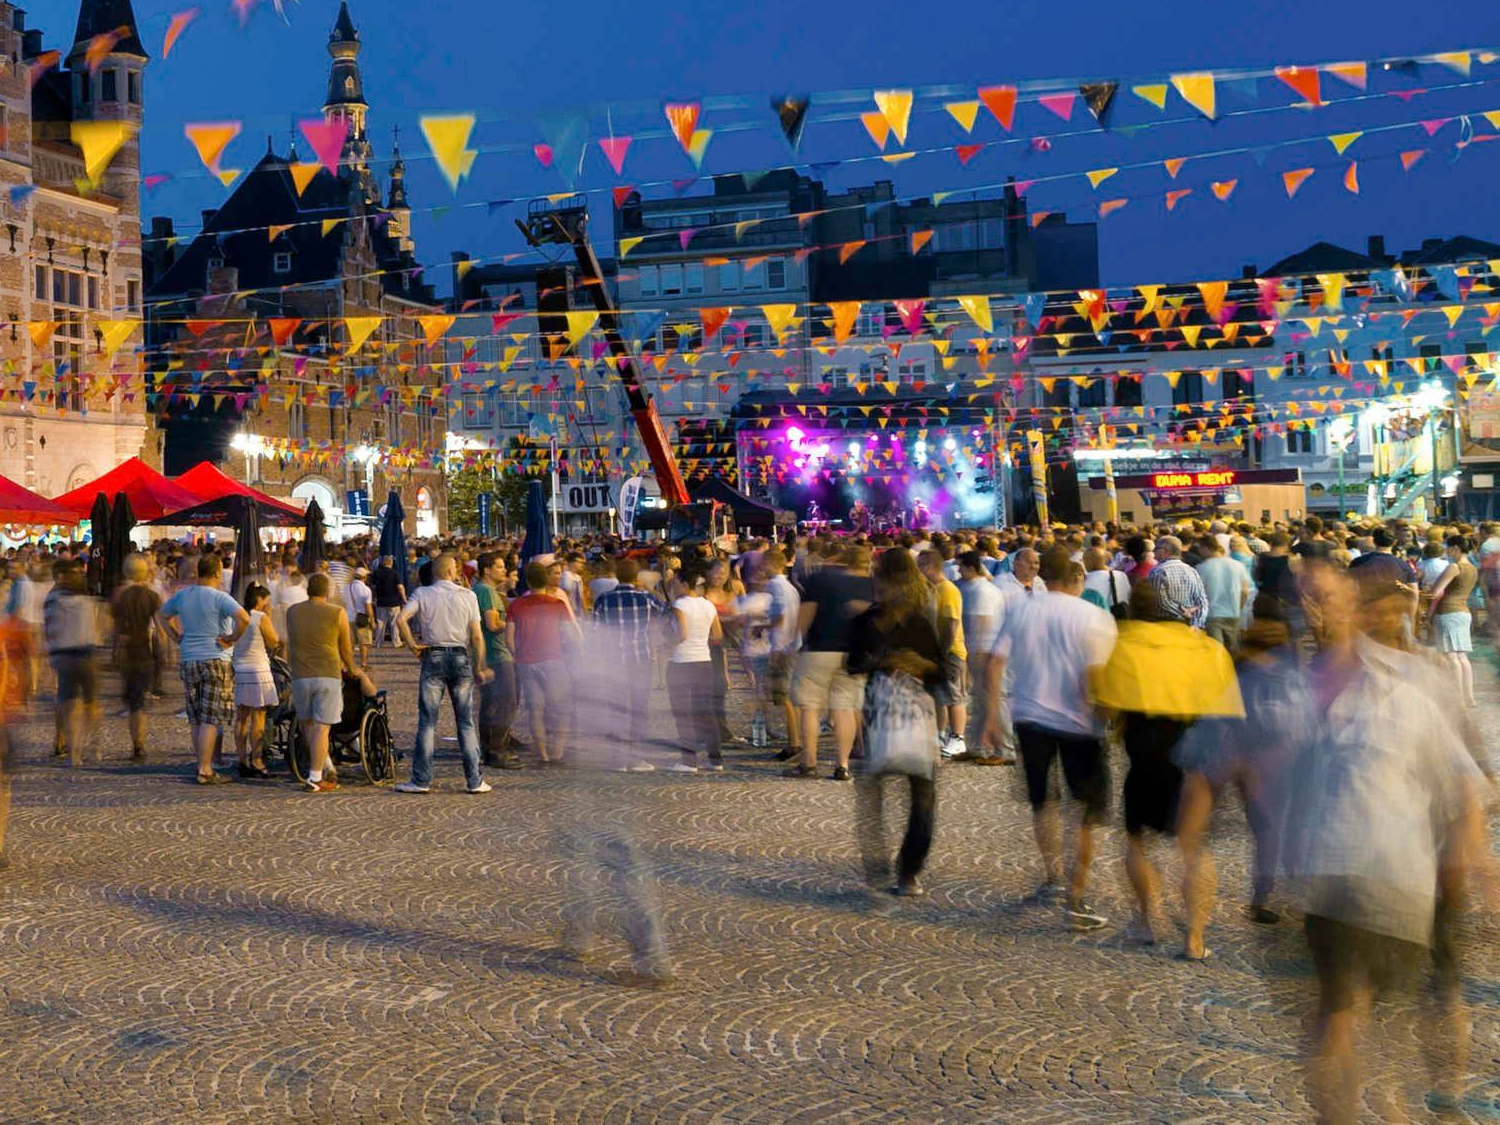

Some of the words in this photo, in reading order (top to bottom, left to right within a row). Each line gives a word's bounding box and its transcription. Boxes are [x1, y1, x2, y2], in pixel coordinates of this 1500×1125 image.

[1155, 474, 1193, 488] DUMA
[1197, 472, 1235, 486] RENT
[569, 485, 610, 508] OUT
